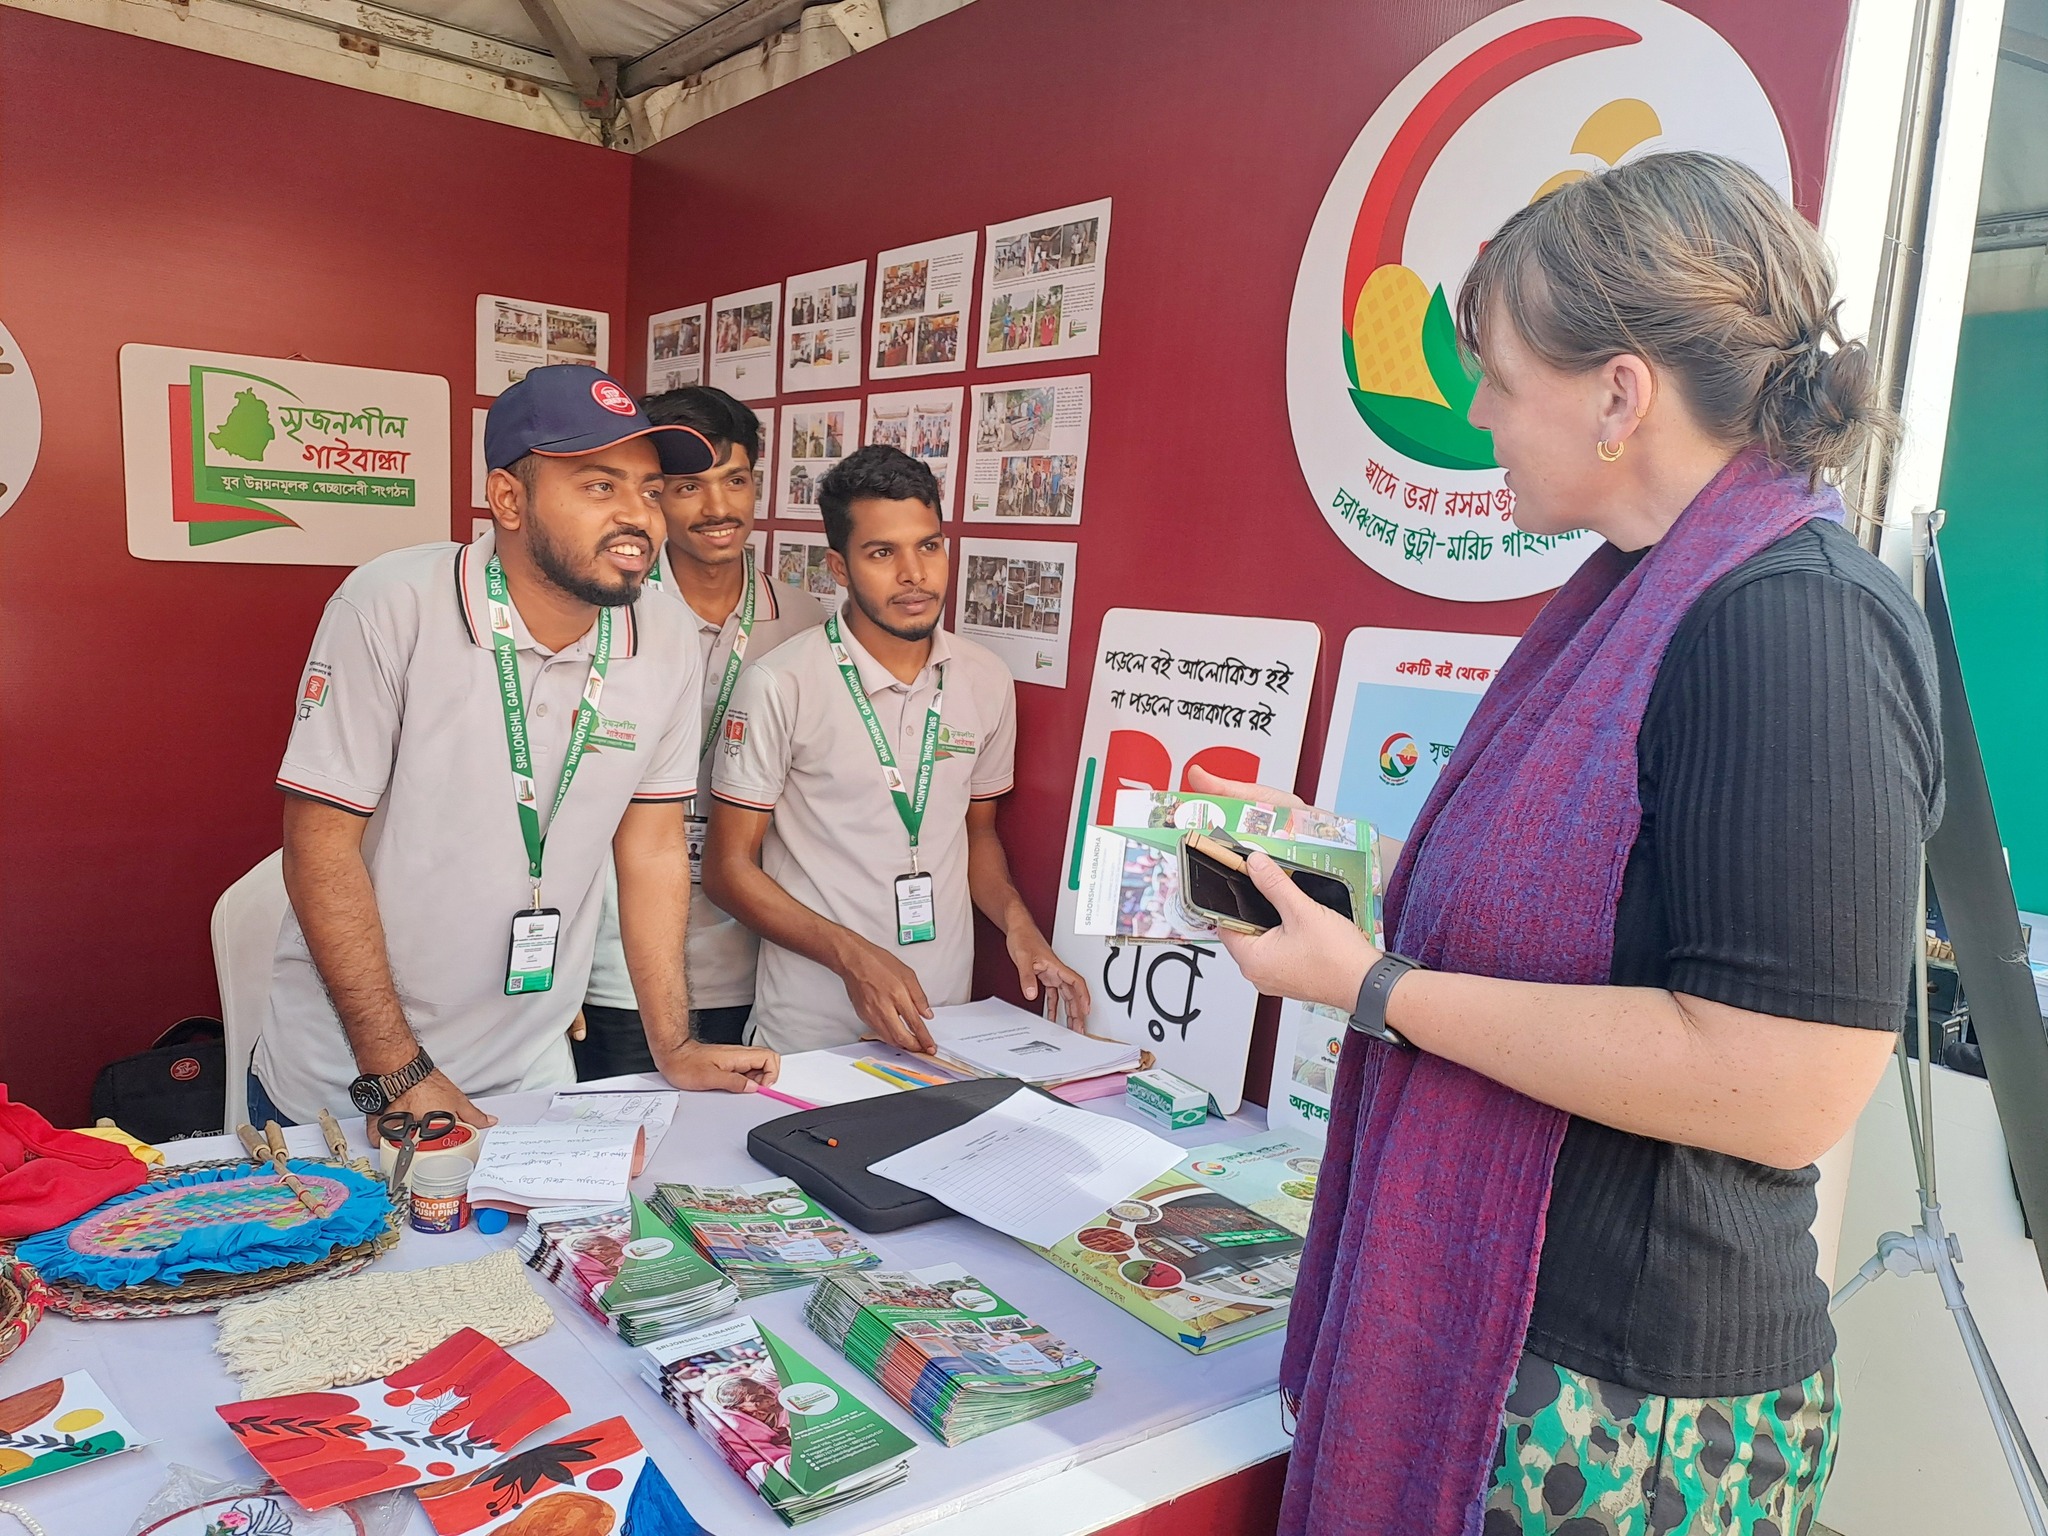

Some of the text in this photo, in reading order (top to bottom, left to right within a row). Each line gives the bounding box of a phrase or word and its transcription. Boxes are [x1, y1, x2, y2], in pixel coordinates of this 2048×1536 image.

[278, 406, 409, 443] সৃজনশীল
[302, 437, 411, 474] গাইবান্ধা
[221, 474, 411, 499] যুব উন্নয়নমূলক স্বেচ্ছাসেবী সংগঠন
[1366, 458, 1400, 499] স্বাদে
[1403, 482, 1439, 515] ভরা
[1332, 487, 1399, 547] চরাঞ্চলের
[596, 606, 611, 665] GAIBANDHA
[718, 658, 739, 703] SRIJONSHIL
[1105, 648, 1295, 695] পড়লে বই আলোকিত হই
[1396, 657, 1491, 682] একটি বই থেকে
[499, 643, 528, 769] SRIJONSHIL GAIBANDHA
[845, 669, 891, 764] SRIJONSHIL GAIBANDHA
[1111, 689, 1277, 736] না পড়লে অন্ধকারে রই
[566, 708, 591, 767] SRIJONSHIL
[914, 716, 938, 814] SRIJONSHIL GAIBANDHA
[1084, 836, 1102, 926] SRIJONSHIL GAIBANDHA
[414, 1199, 459, 1210] COLORED
[414, 1207, 459, 1217] PUSH PINS
[656, 1336, 701, 1351] SRIJONSHIL
[702, 1322, 746, 1338] GAIBANDHA
